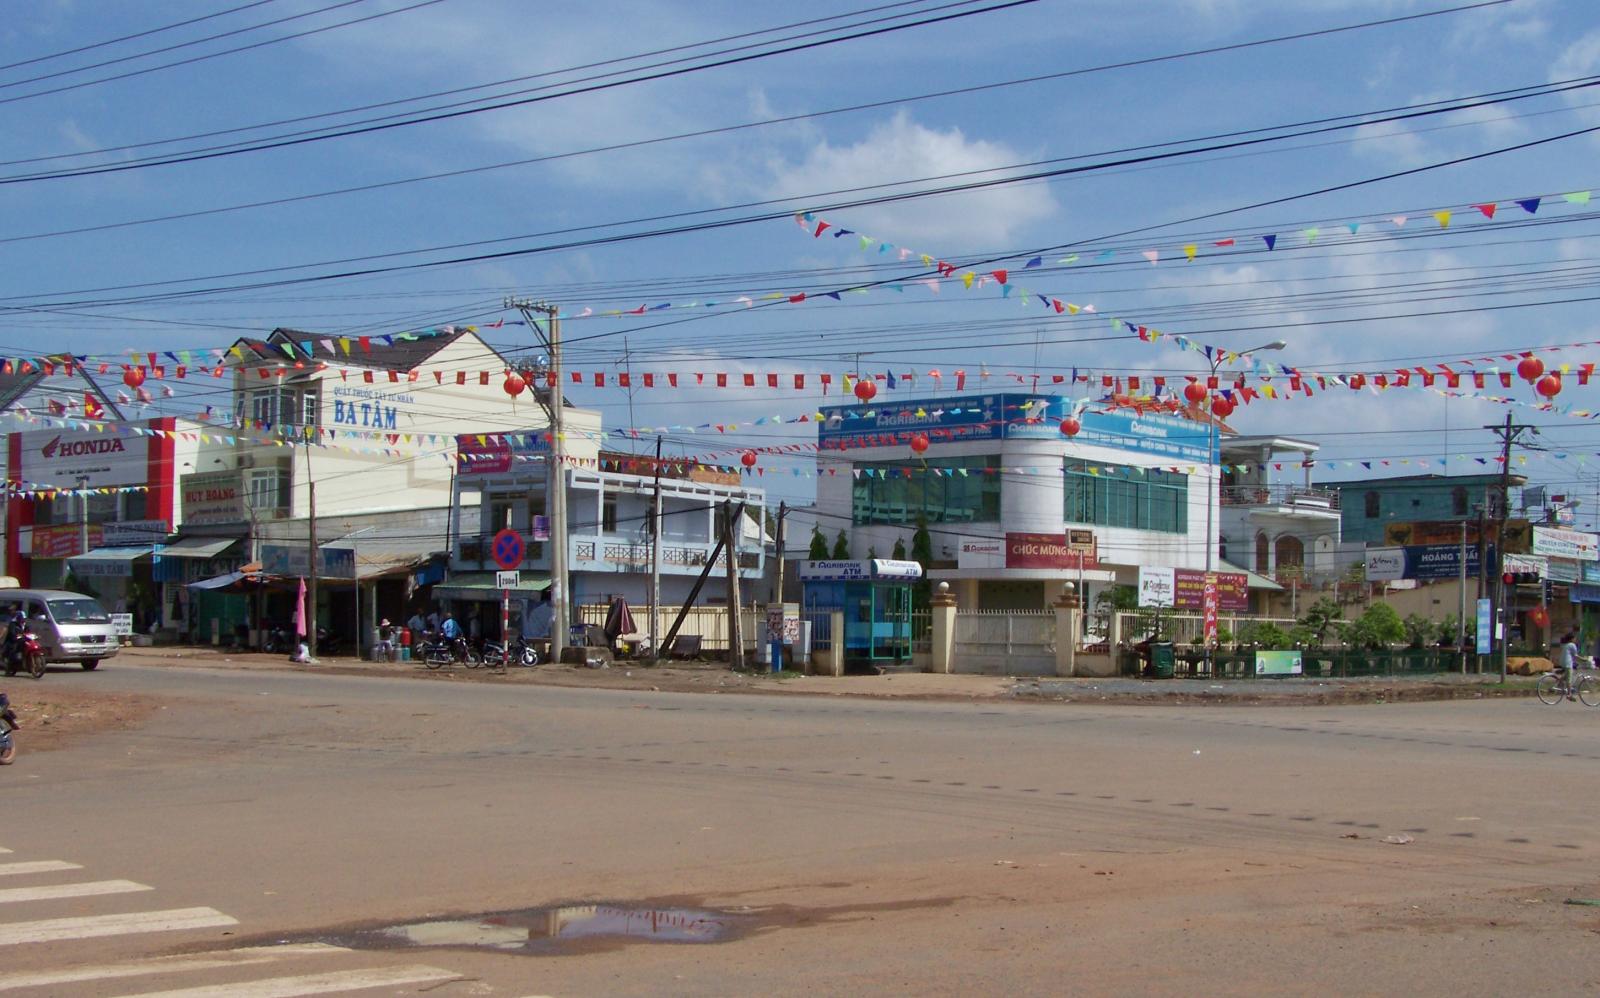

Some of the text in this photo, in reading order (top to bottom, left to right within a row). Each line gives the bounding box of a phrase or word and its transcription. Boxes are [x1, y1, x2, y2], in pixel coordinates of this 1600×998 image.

[334, 399, 397, 430] BA TÂM
[60, 437, 125, 457] HONDA
[1012, 543, 1039, 555] CHÚC
[1040, 543, 1067, 556] MỪNG
[1457, 549, 1479, 561] TÁI
[818, 561, 861, 569] AGRIBANK
[843, 568, 862, 576] ATM
[905, 568, 919, 576] ATM
